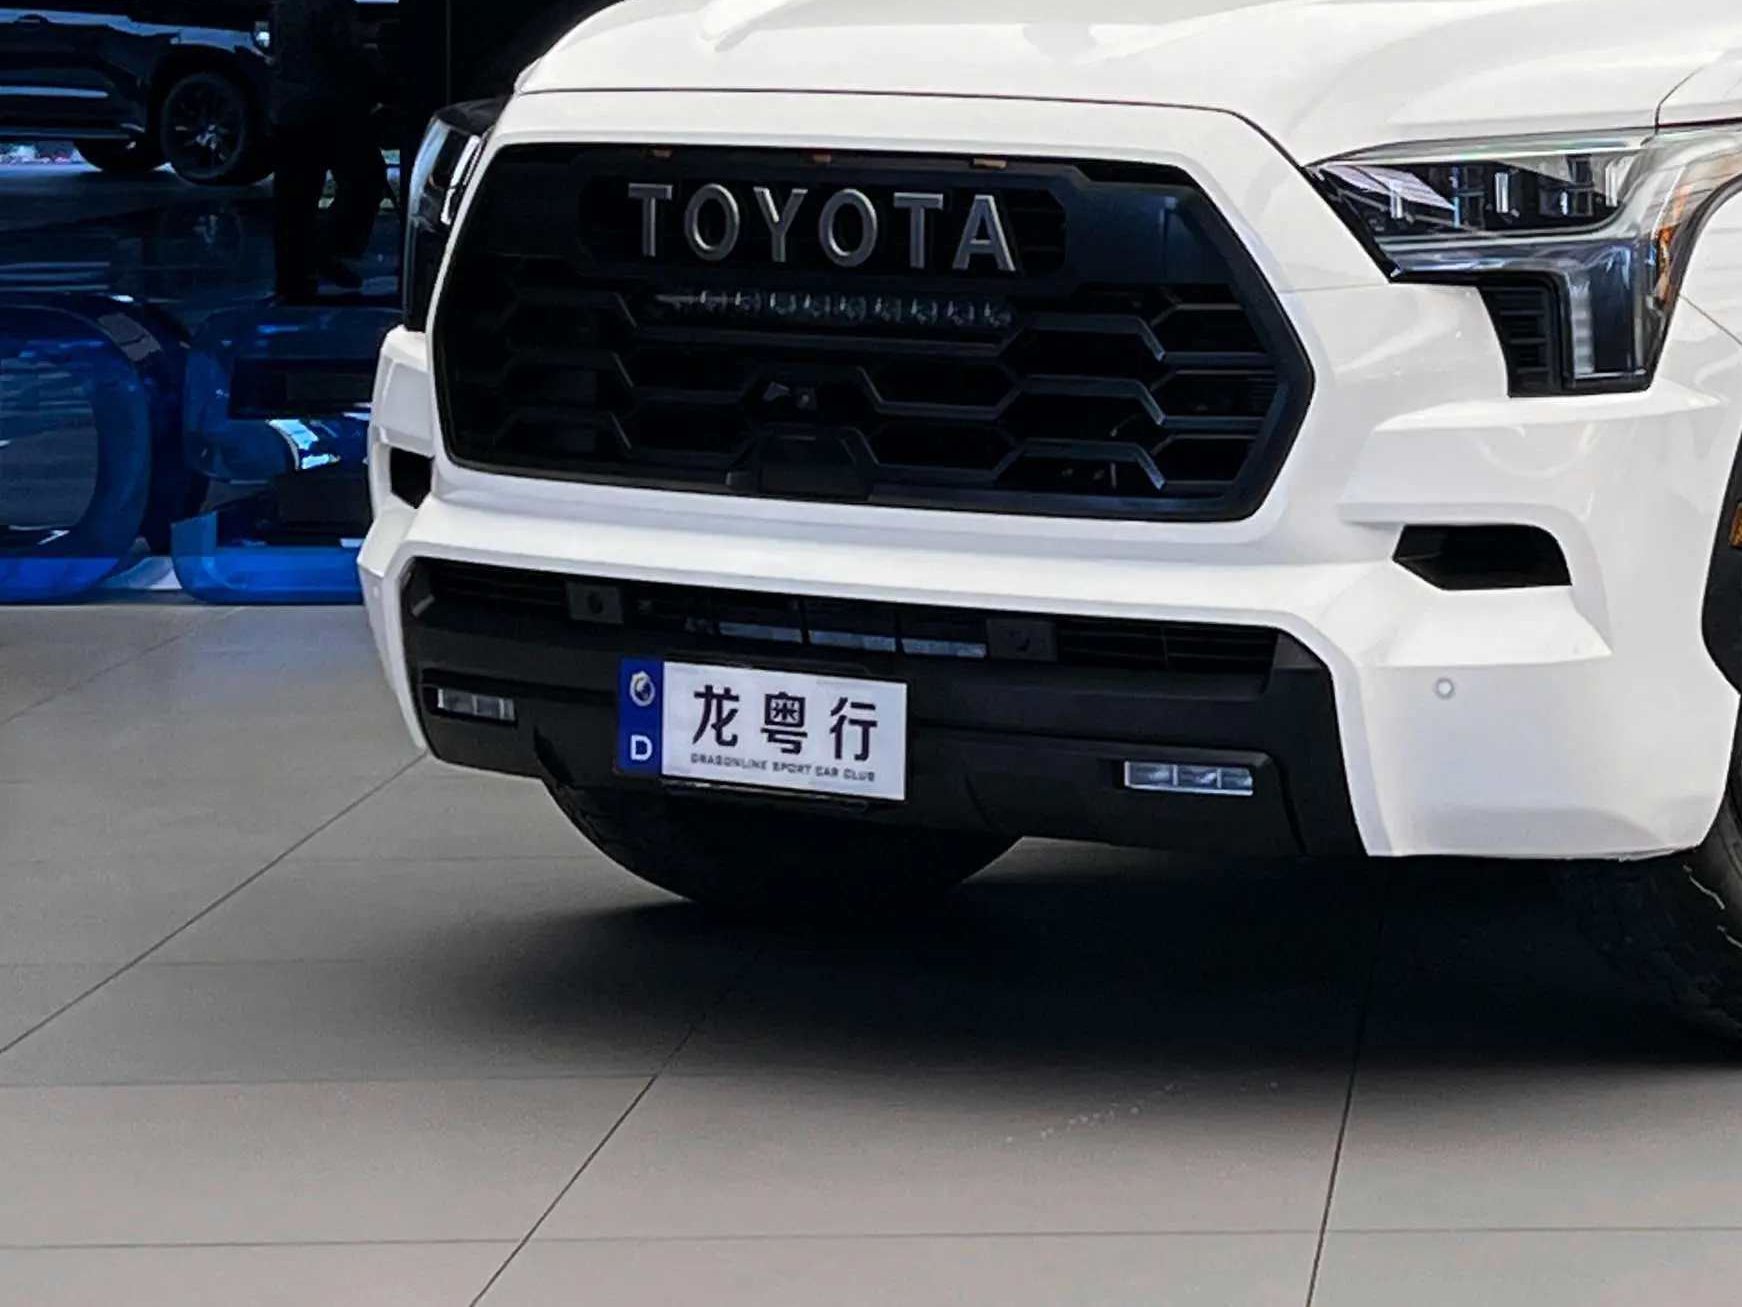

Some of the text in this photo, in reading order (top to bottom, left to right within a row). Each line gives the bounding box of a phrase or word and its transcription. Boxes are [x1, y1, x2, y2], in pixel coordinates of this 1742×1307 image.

[627, 182, 1017, 272] TOYOTA
[629, 734, 653, 761] D
[691, 684, 878, 762] 龙粤行
[772, 761, 812, 775] SPORT
[815, 765, 839, 778] CAR
[843, 768, 876, 782] CLUB
